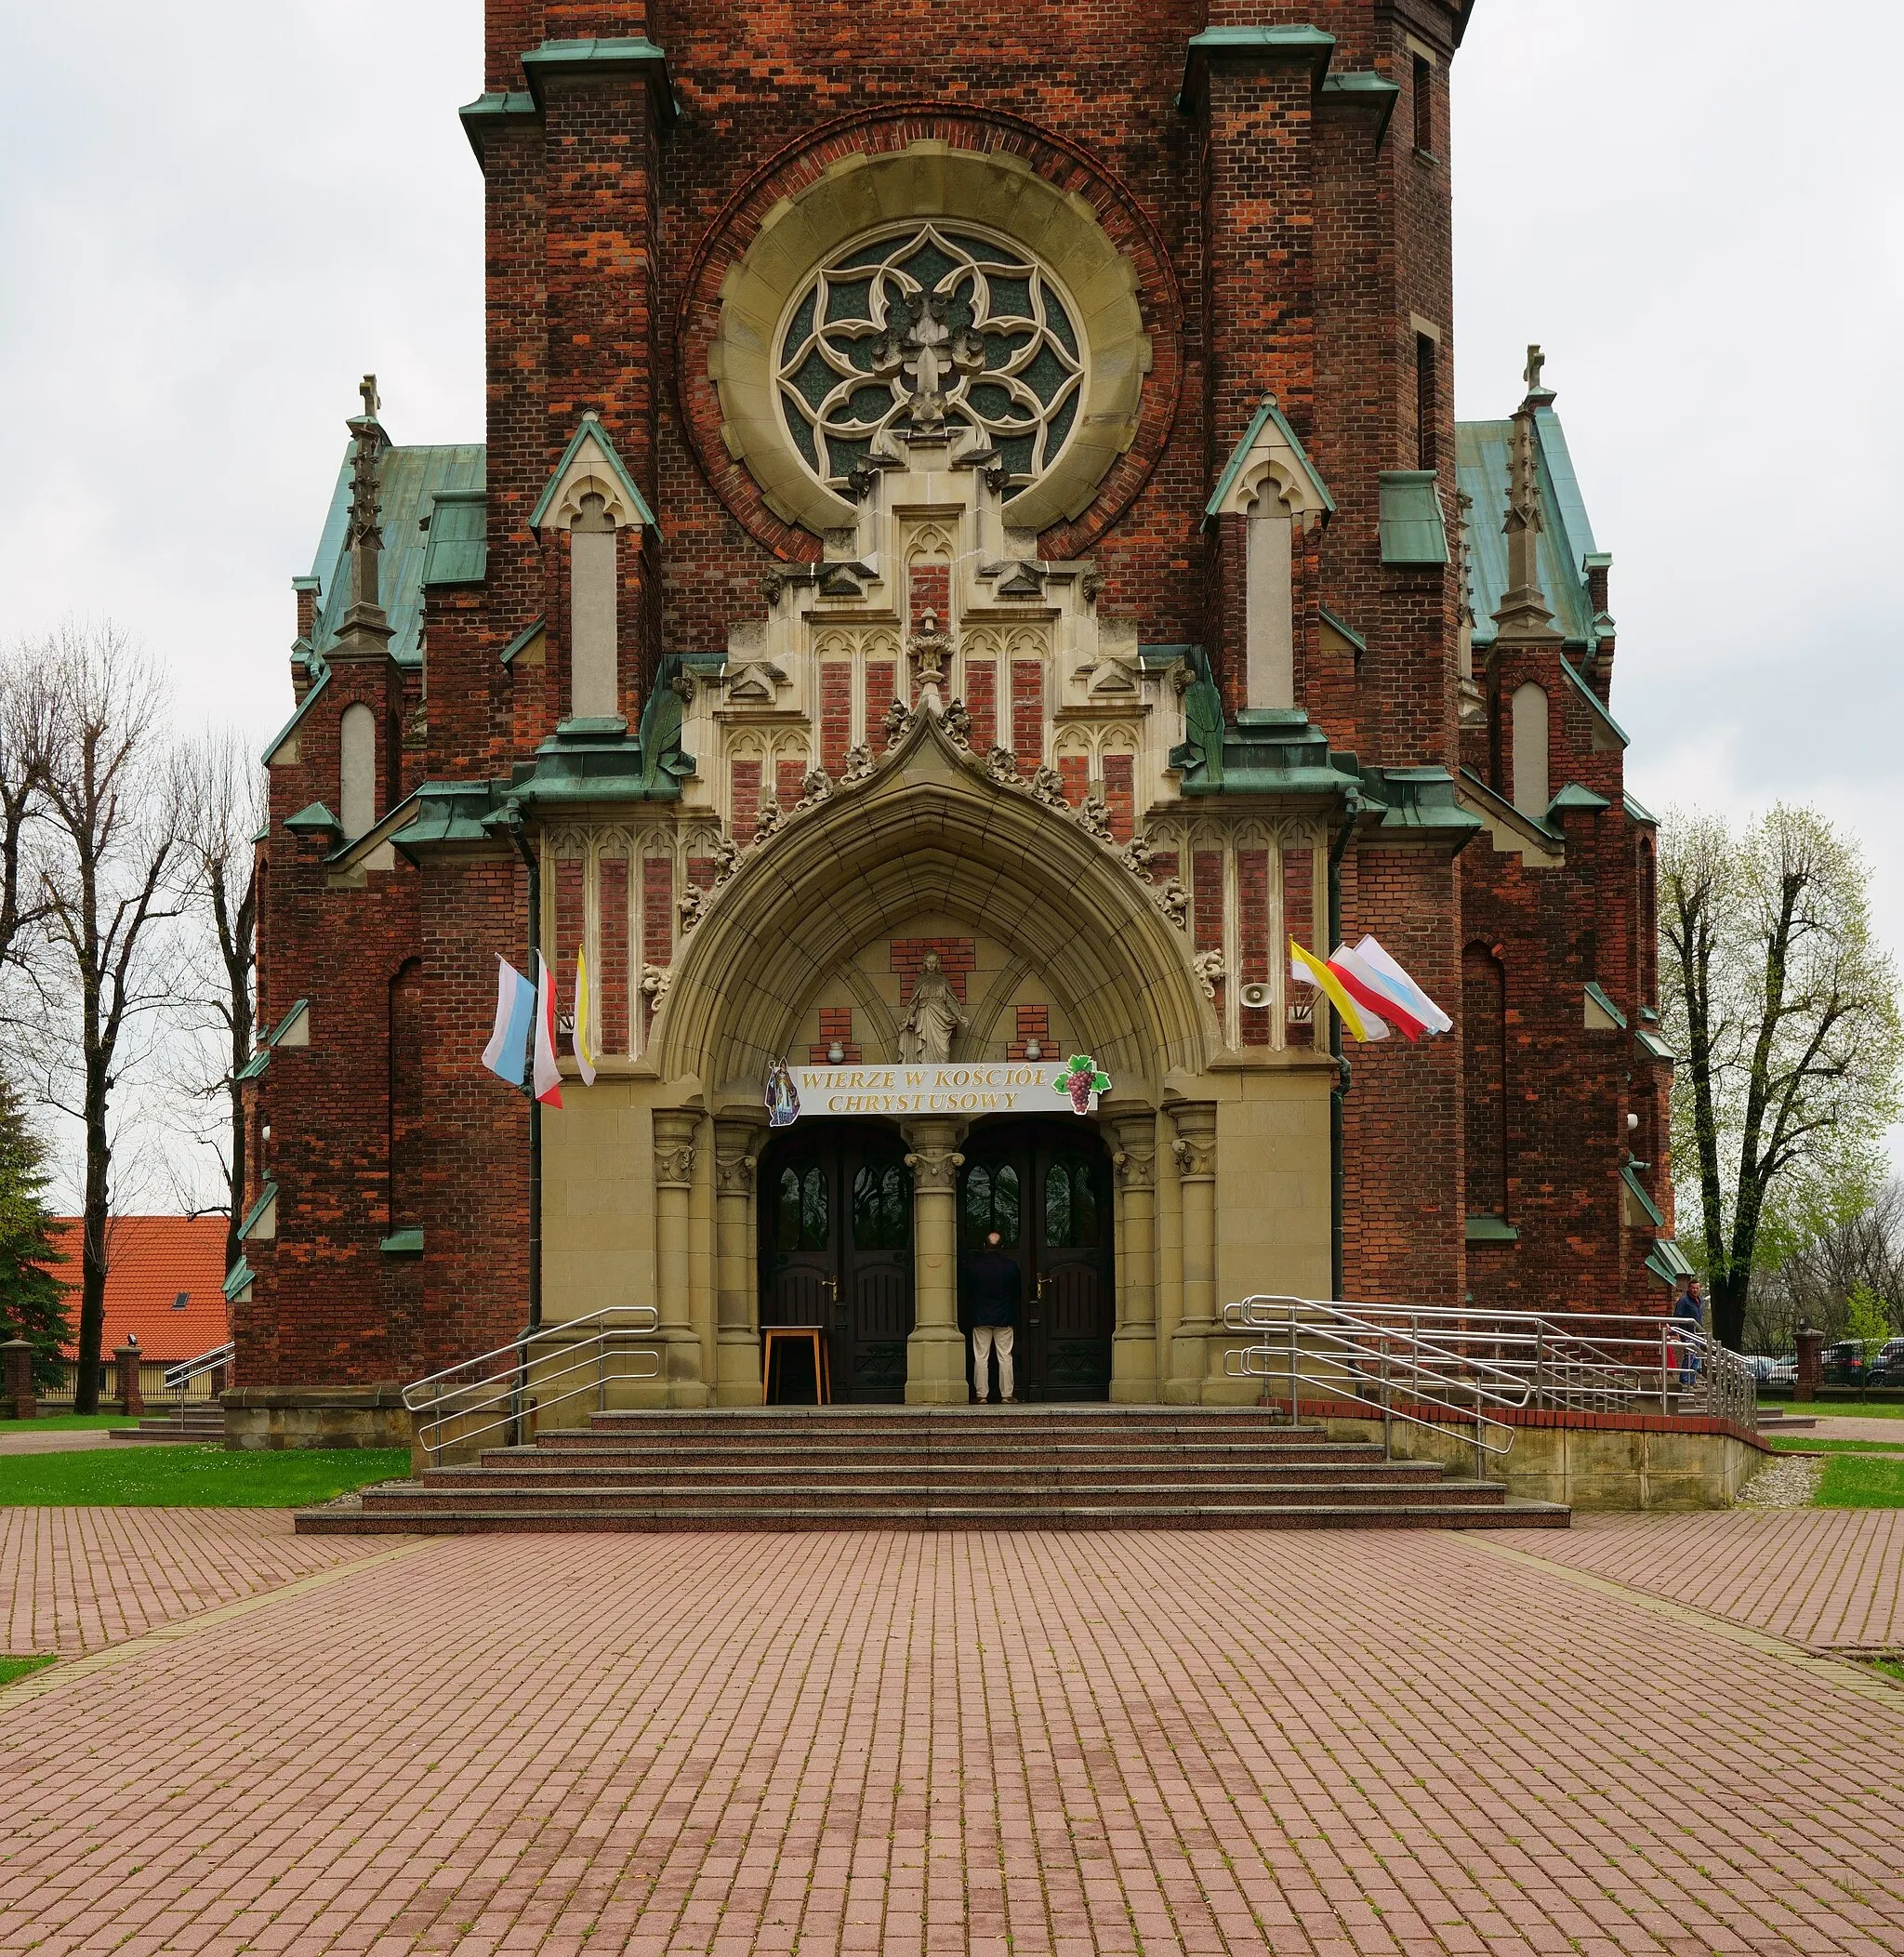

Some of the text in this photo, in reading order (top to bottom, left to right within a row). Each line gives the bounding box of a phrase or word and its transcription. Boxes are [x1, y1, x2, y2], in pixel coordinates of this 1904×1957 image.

[801, 1063, 1048, 1091] WIERZĘ W KOŚCIÓŁ
[827, 1091, 1019, 1112] CHRYSTUSOWY
